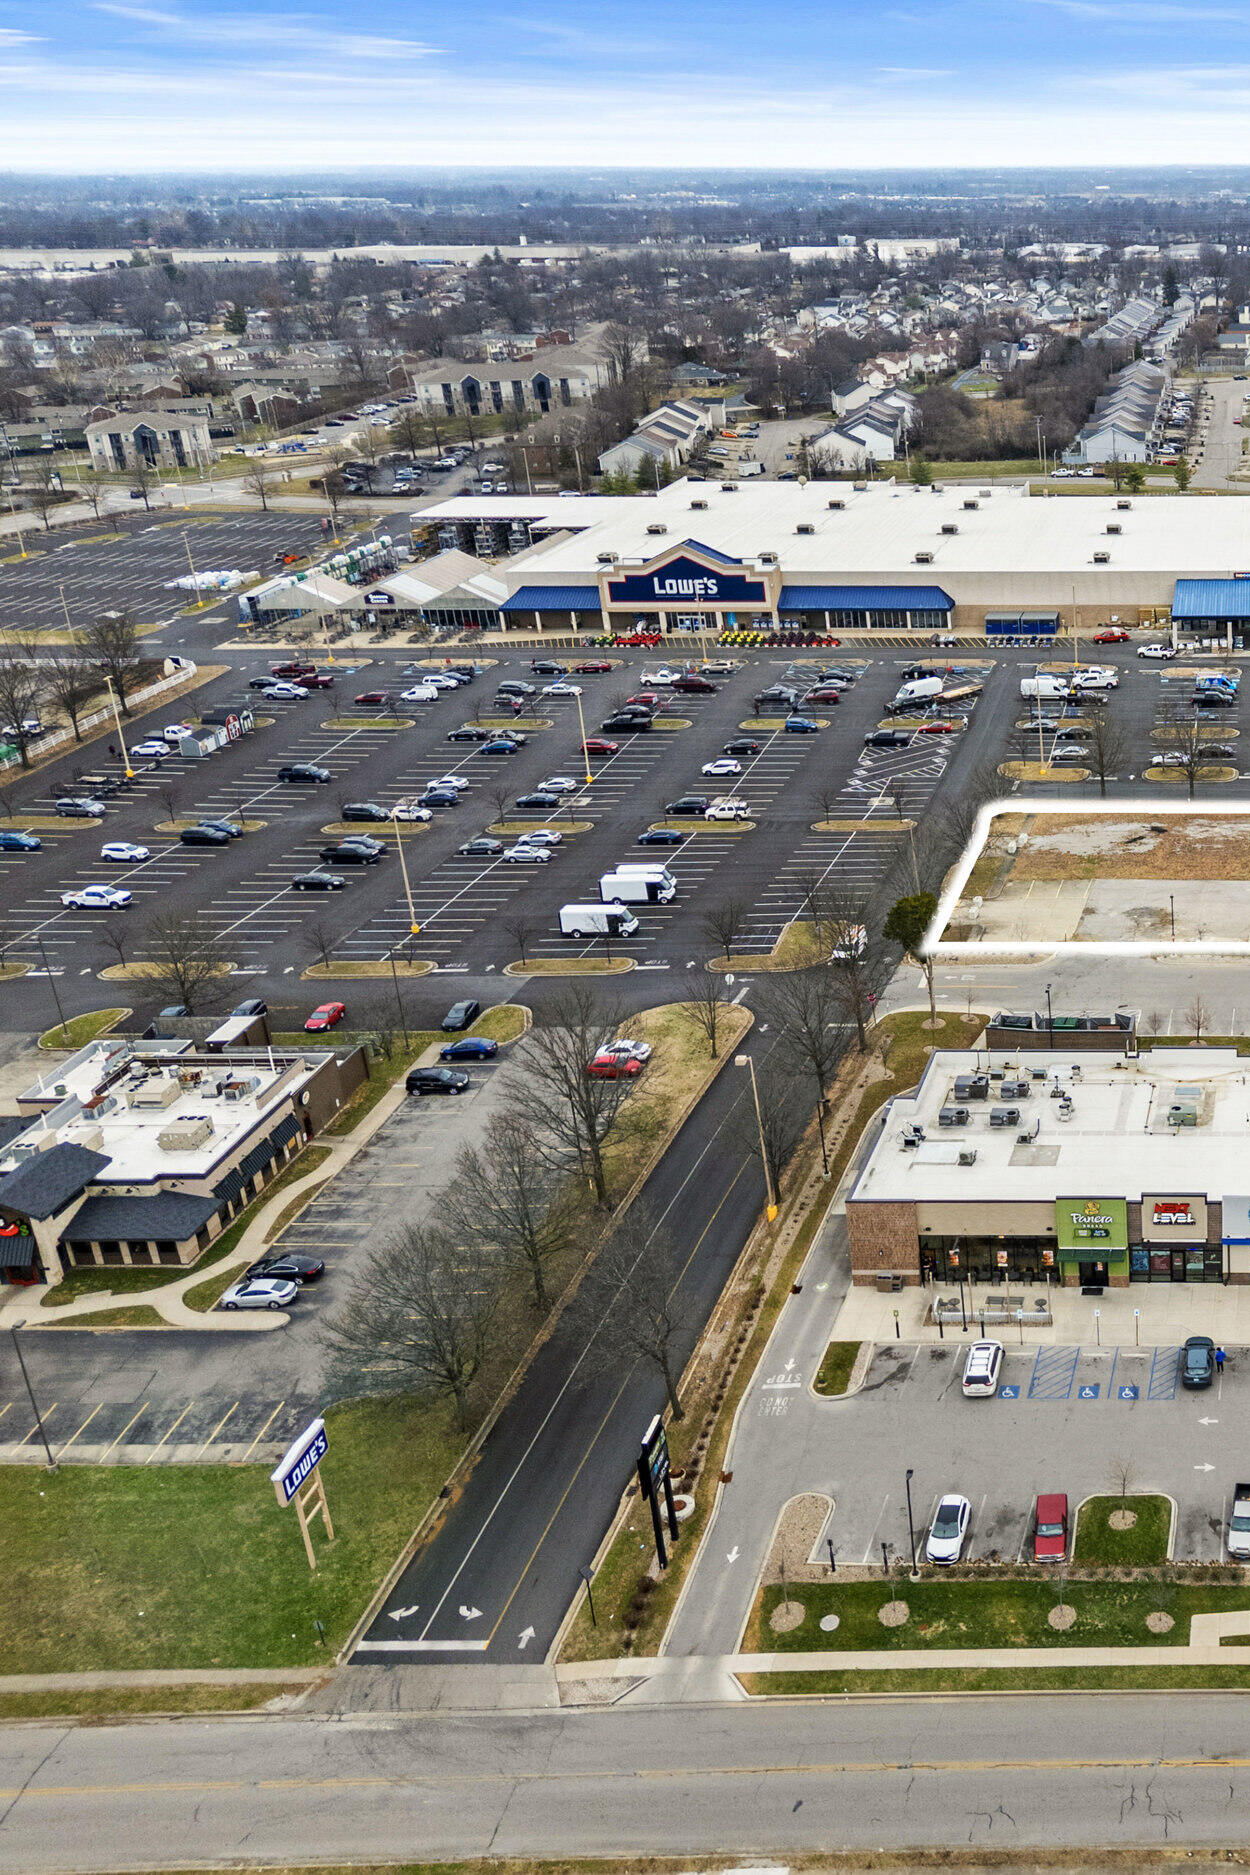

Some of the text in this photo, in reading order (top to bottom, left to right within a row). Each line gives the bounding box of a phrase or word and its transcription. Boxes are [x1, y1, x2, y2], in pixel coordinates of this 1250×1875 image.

[653, 577, 718, 595] LOWE'S
[1154, 1203, 1190, 1214] NEXT
[1070, 1212, 1113, 1224] Panera
[1153, 1212, 1195, 1224] LEVEL
[766, 1373, 802, 1384] STOP
[284, 1434, 326, 1497] LOWE'S
